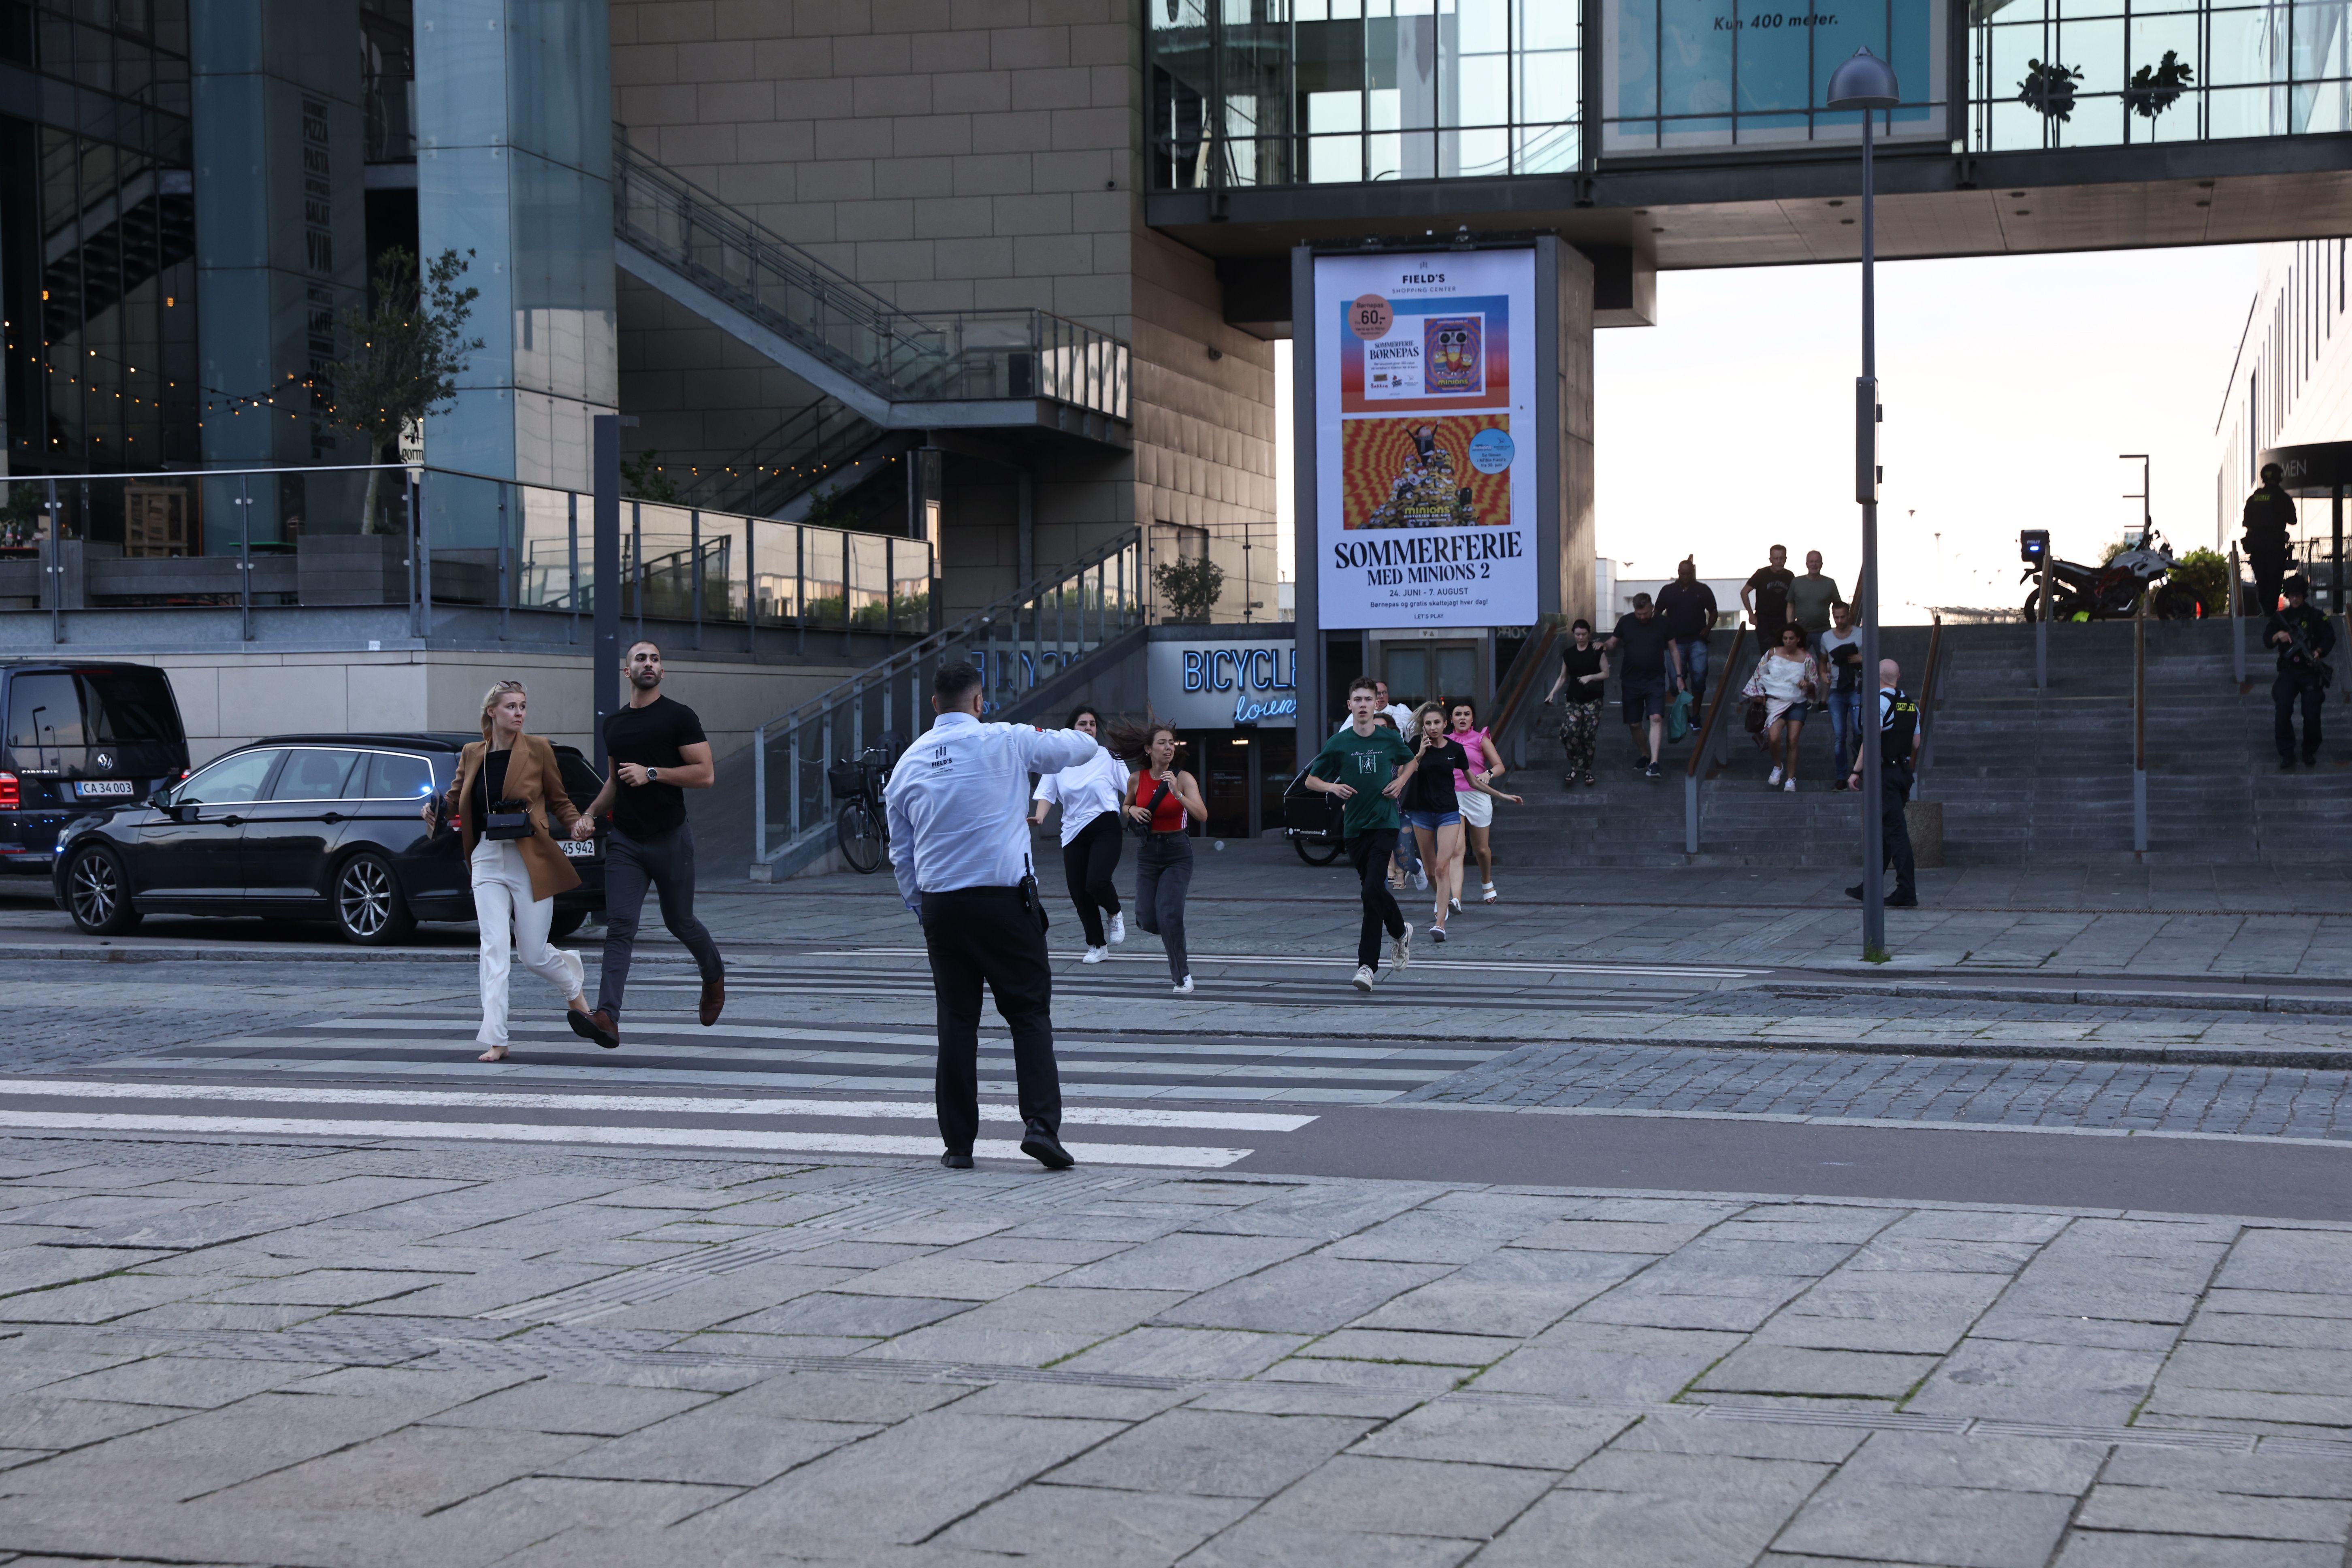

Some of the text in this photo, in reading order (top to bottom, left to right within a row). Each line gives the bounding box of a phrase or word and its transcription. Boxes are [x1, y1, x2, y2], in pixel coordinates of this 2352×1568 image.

[1714, 13, 1838, 30] Kun 400 meter.
[303, 115, 328, 145] PIZZA
[304, 147, 329, 175] PASTA
[1402, 273, 1445, 283] FIELD'S
[1361, 310, 1386, 325] 60,-
[1375, 340, 1414, 348] SOMMERFERIE
[1370, 347, 1419, 360] BØRNEPAS
[1334, 531, 1522, 569] SOMMERFERIE
[1368, 562, 1490, 586] MED MINIONS 2
[1410, 600, 1427, 608] gratis
[1183, 648, 1296, 692] BICYCL
[1235, 695, 1296, 721] loun
[931, 758, 952, 767] FIELD'S
[83, 783, 132, 793] CA 34 003
[562, 842, 593, 854] 45 942
